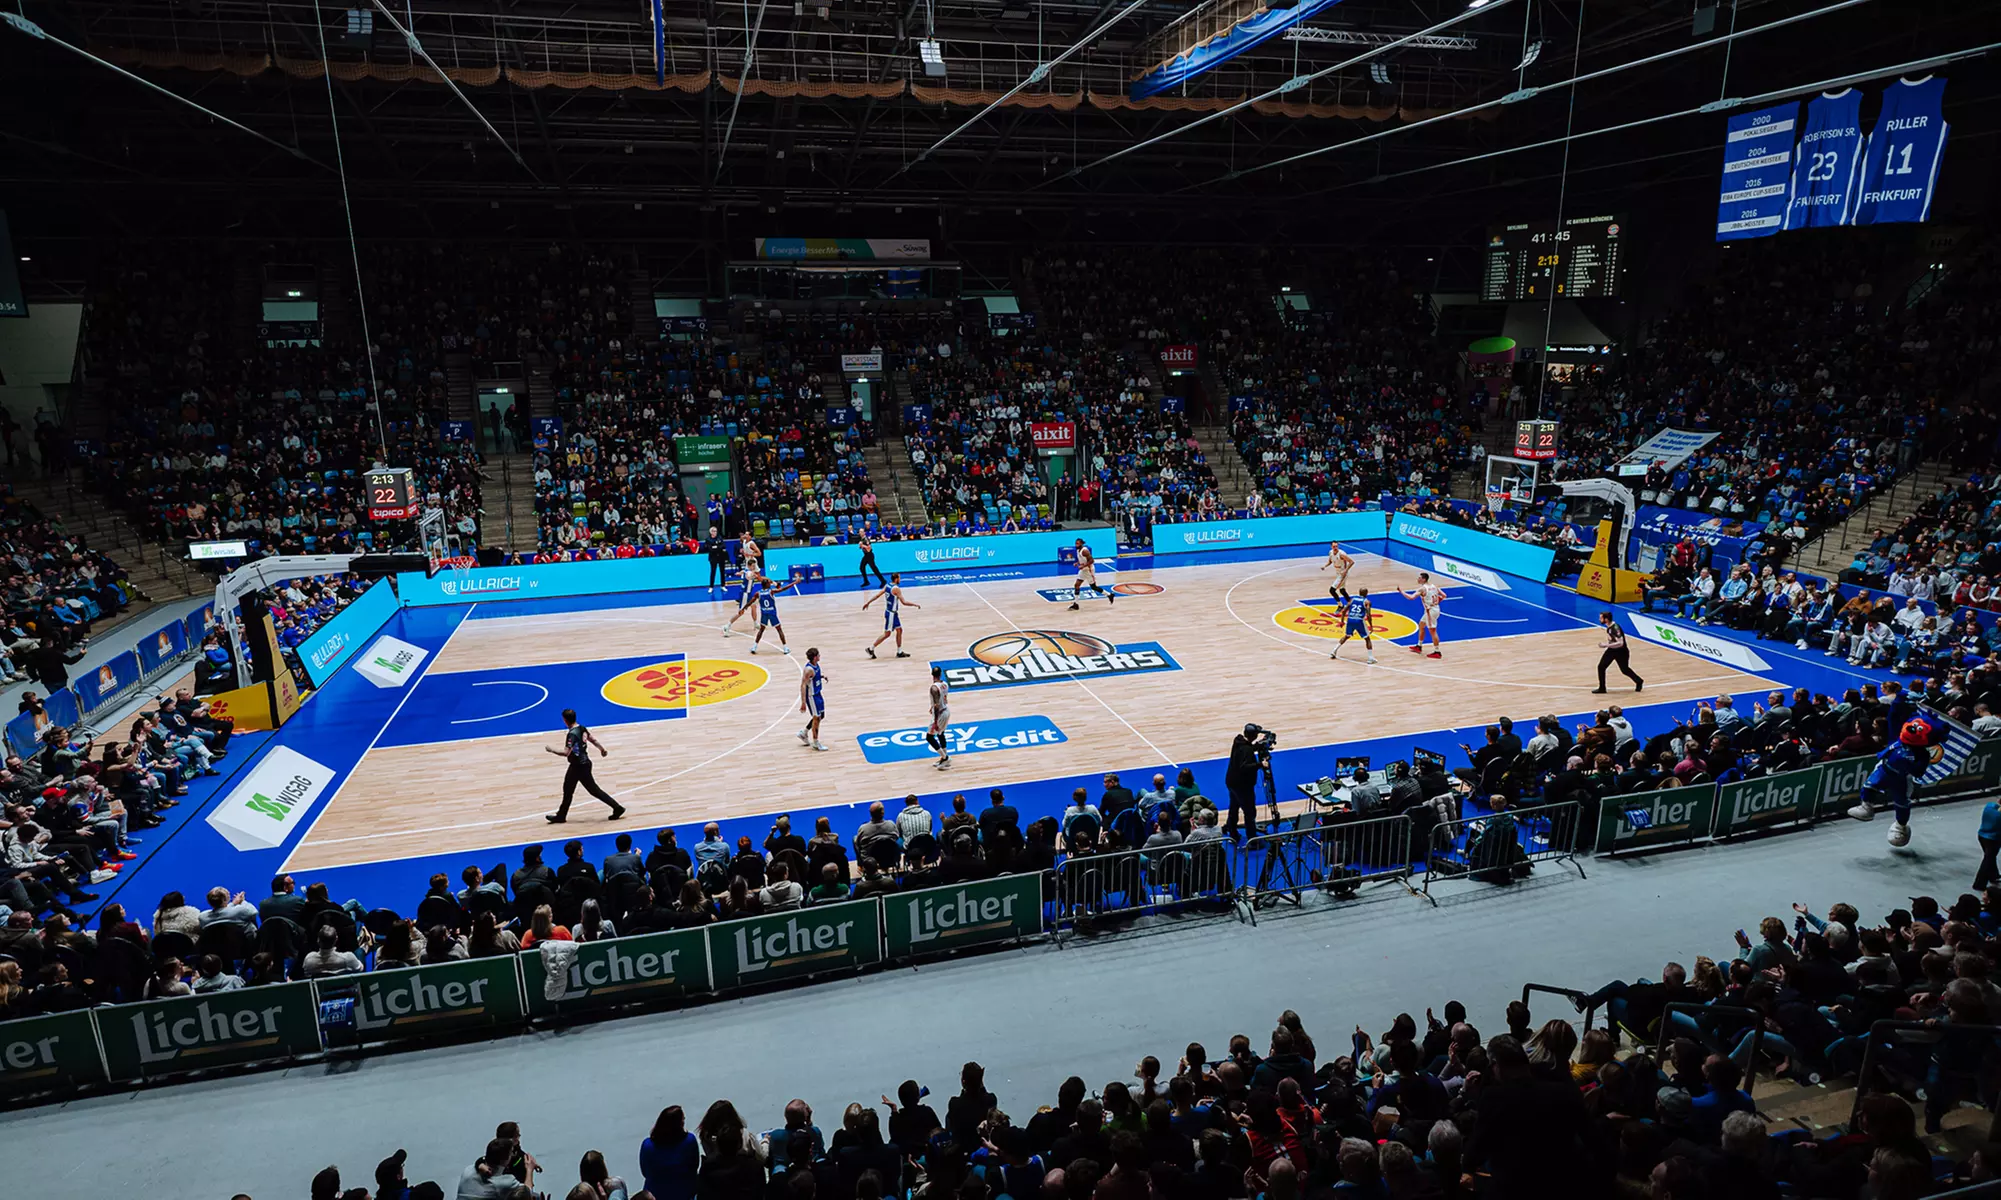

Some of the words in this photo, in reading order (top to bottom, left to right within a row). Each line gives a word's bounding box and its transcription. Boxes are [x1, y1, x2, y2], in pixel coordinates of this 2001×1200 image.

[1752, 115, 1771, 126] 2000
[1748, 147, 1766, 157] 2004
[1808, 151, 1838, 181] 23
[1744, 178, 1762, 188] 2016
[1741, 208, 1757, 218] 2016
[1531, 233, 1545, 243] 41
[1554, 231, 1571, 241] 45
[903, 243, 927, 253] Süwag
[1537, 255, 1559, 267] 2:13
[1528, 285, 1535, 295] 4
[1557, 285, 1564, 294] 3
[1160, 348, 1194, 361] aixit
[454, 428, 460, 436] P
[545, 424, 551, 432] P
[1033, 426, 1071, 440] aixit
[1540, 424, 1554, 432] 2:13
[1518, 434, 1529, 445] 22
[1540, 434, 1553, 446] 22
[372, 474, 395, 485] 2:13
[374, 488, 397, 504] 22
[372, 508, 404, 518] tipico
[1197, 529, 1241, 541] ULLRICH
[1407, 524, 1440, 541] ULLRICH
[930, 546, 980, 559] ULLRICH
[460, 576, 520, 591] ULLRICH
[763, 600, 770, 608] 0
[1351, 604, 1362, 613] 25
[1679, 637, 1723, 657] wisag
[946, 647, 1166, 687] SKYLINERS
[651, 669, 740, 703] LOTTO
[696, 679, 747, 699] Hessen
[276, 775, 312, 807] wisag
[1822, 767, 1867, 803] Lich
[1731, 780, 1805, 825] Licher
[907, 889, 1018, 943] Licher
[734, 916, 854, 974] Licher
[353, 973, 488, 1031] Licher
[129, 1001, 283, 1064] Licher
